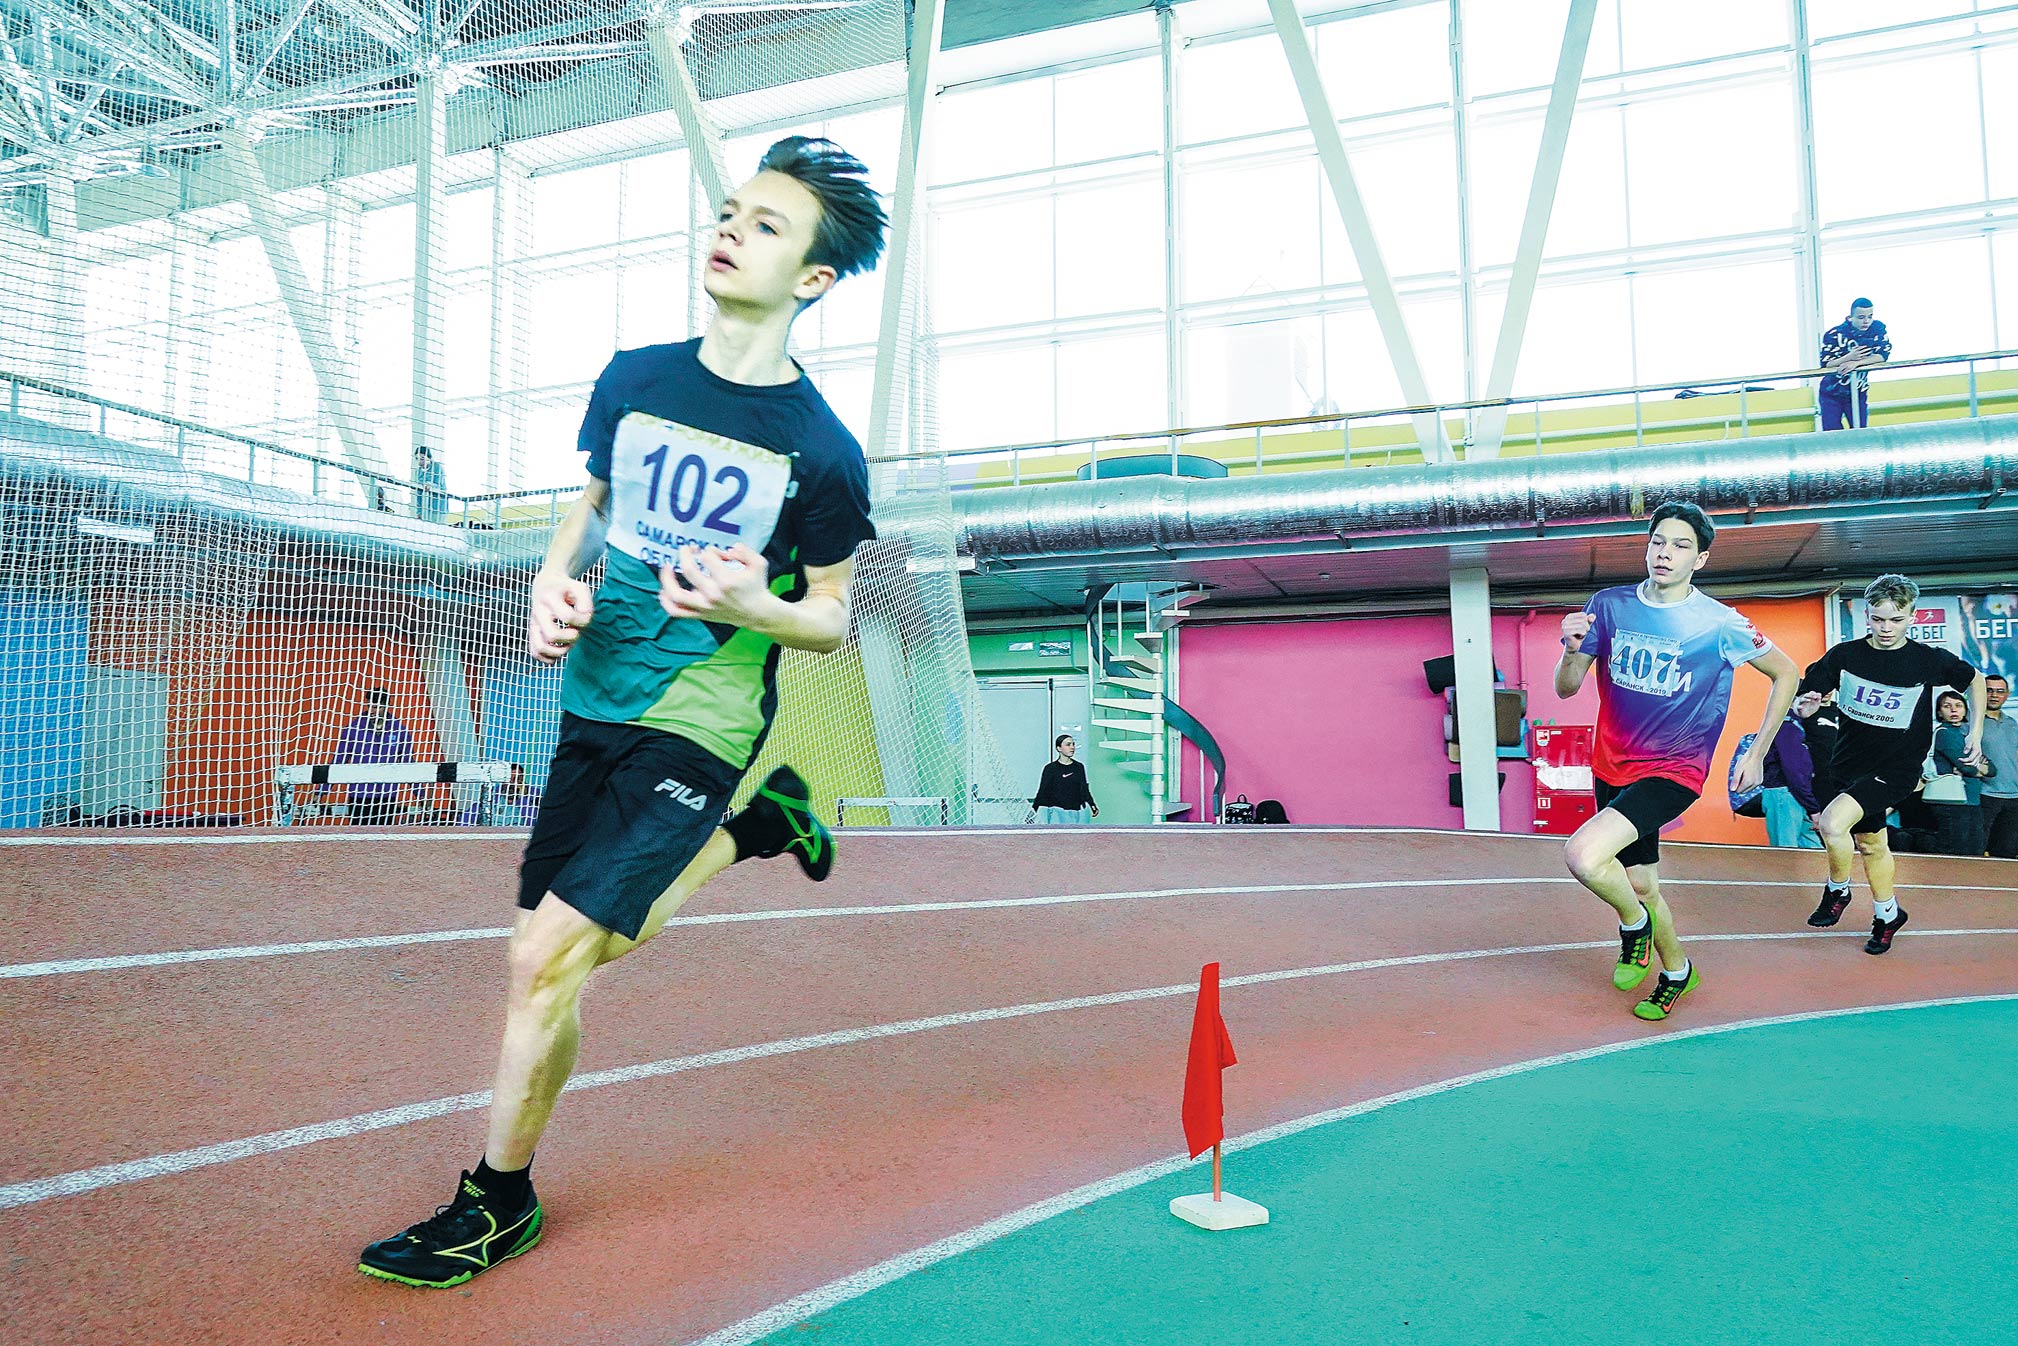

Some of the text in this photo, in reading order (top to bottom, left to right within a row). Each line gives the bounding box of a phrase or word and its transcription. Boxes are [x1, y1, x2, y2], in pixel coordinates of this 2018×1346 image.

[643, 443, 749, 536] 102
[1922, 625, 1947, 640] БЕГ
[1612, 645, 1678, 684] 407
[1615, 677, 1645, 692] САРАНСК
[1649, 687, 1667, 695] 2019
[1853, 685, 1905, 711] 155
[653, 778, 708, 811] FILA
